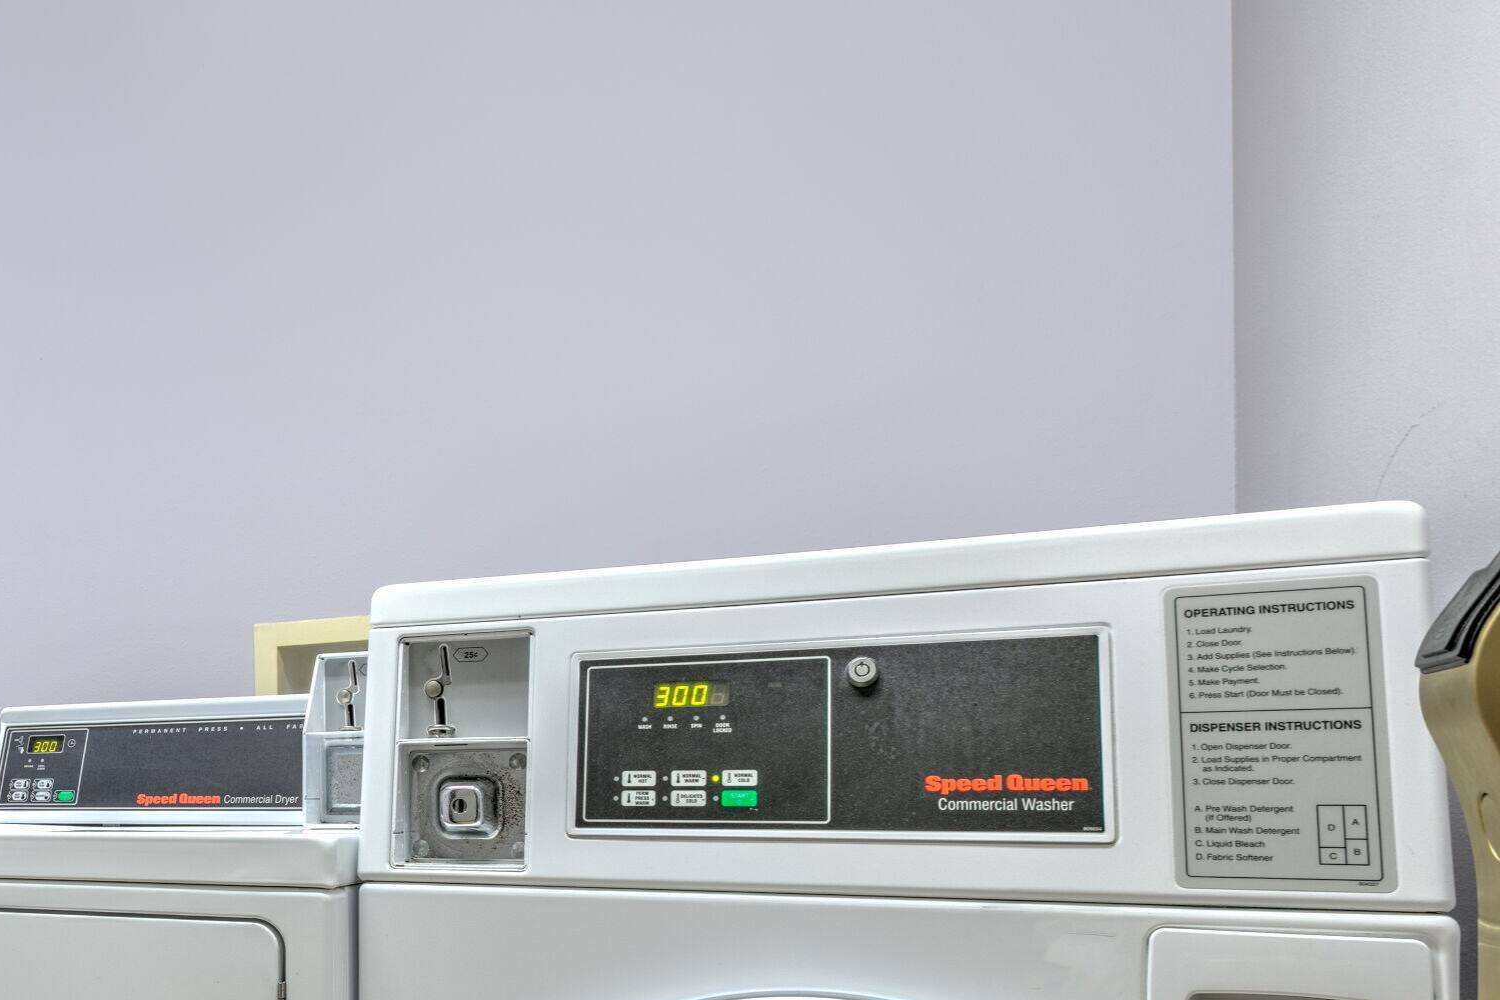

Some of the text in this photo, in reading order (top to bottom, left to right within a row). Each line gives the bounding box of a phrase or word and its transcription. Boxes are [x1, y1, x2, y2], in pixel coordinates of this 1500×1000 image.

[1184, 600, 1355, 619] OPERATING INSTRUCTIONS
[1195, 627, 1216, 635] Load
[1197, 653, 1214, 661] Add
[1215, 652, 1250, 662] Supplies
[1252, 650, 1272, 660] (See
[1275, 648, 1323, 657] Instructions
[1222, 665, 1244, 674] Cycle
[1247, 663, 1288, 672] Selection.
[1222, 677, 1260, 687] Payment.
[655, 684, 709, 708] 300
[1198, 691, 1222, 699] Press
[1246, 690, 1270, 699] (Door
[1272, 689, 1292, 697] Must
[1307, 688, 1343, 697] Closed).
[1190, 720, 1362, 732] DISPENSER INSTRUCTIONS
[34, 742, 58, 753] 300
[1225, 743, 1267, 751] Dispenser
[1269, 742, 1292, 750] Door.
[1224, 756, 1260, 764] Supplies
[1262, 755, 1270, 763] in
[1272, 755, 1300, 763] Proper
[1303, 755, 1362, 763] Compartment
[925, 774, 1088, 795] Speed Queen
[1228, 778, 1270, 786] Dispenser
[136, 792, 299, 806] Speed Queen Commercial Dryer
[938, 798, 1075, 811] Commercial Washer
[1224, 805, 1247, 813] Wash
[1250, 805, 1293, 814] Detergent
[1205, 814, 1252, 822] (If Offered)
[1352, 818, 1359, 826] A
[1255, 827, 1300, 836] Detergent
[1328, 824, 1335, 832] D
[1206, 841, 1233, 849] Liquid
[1236, 854, 1273, 862] Softener
